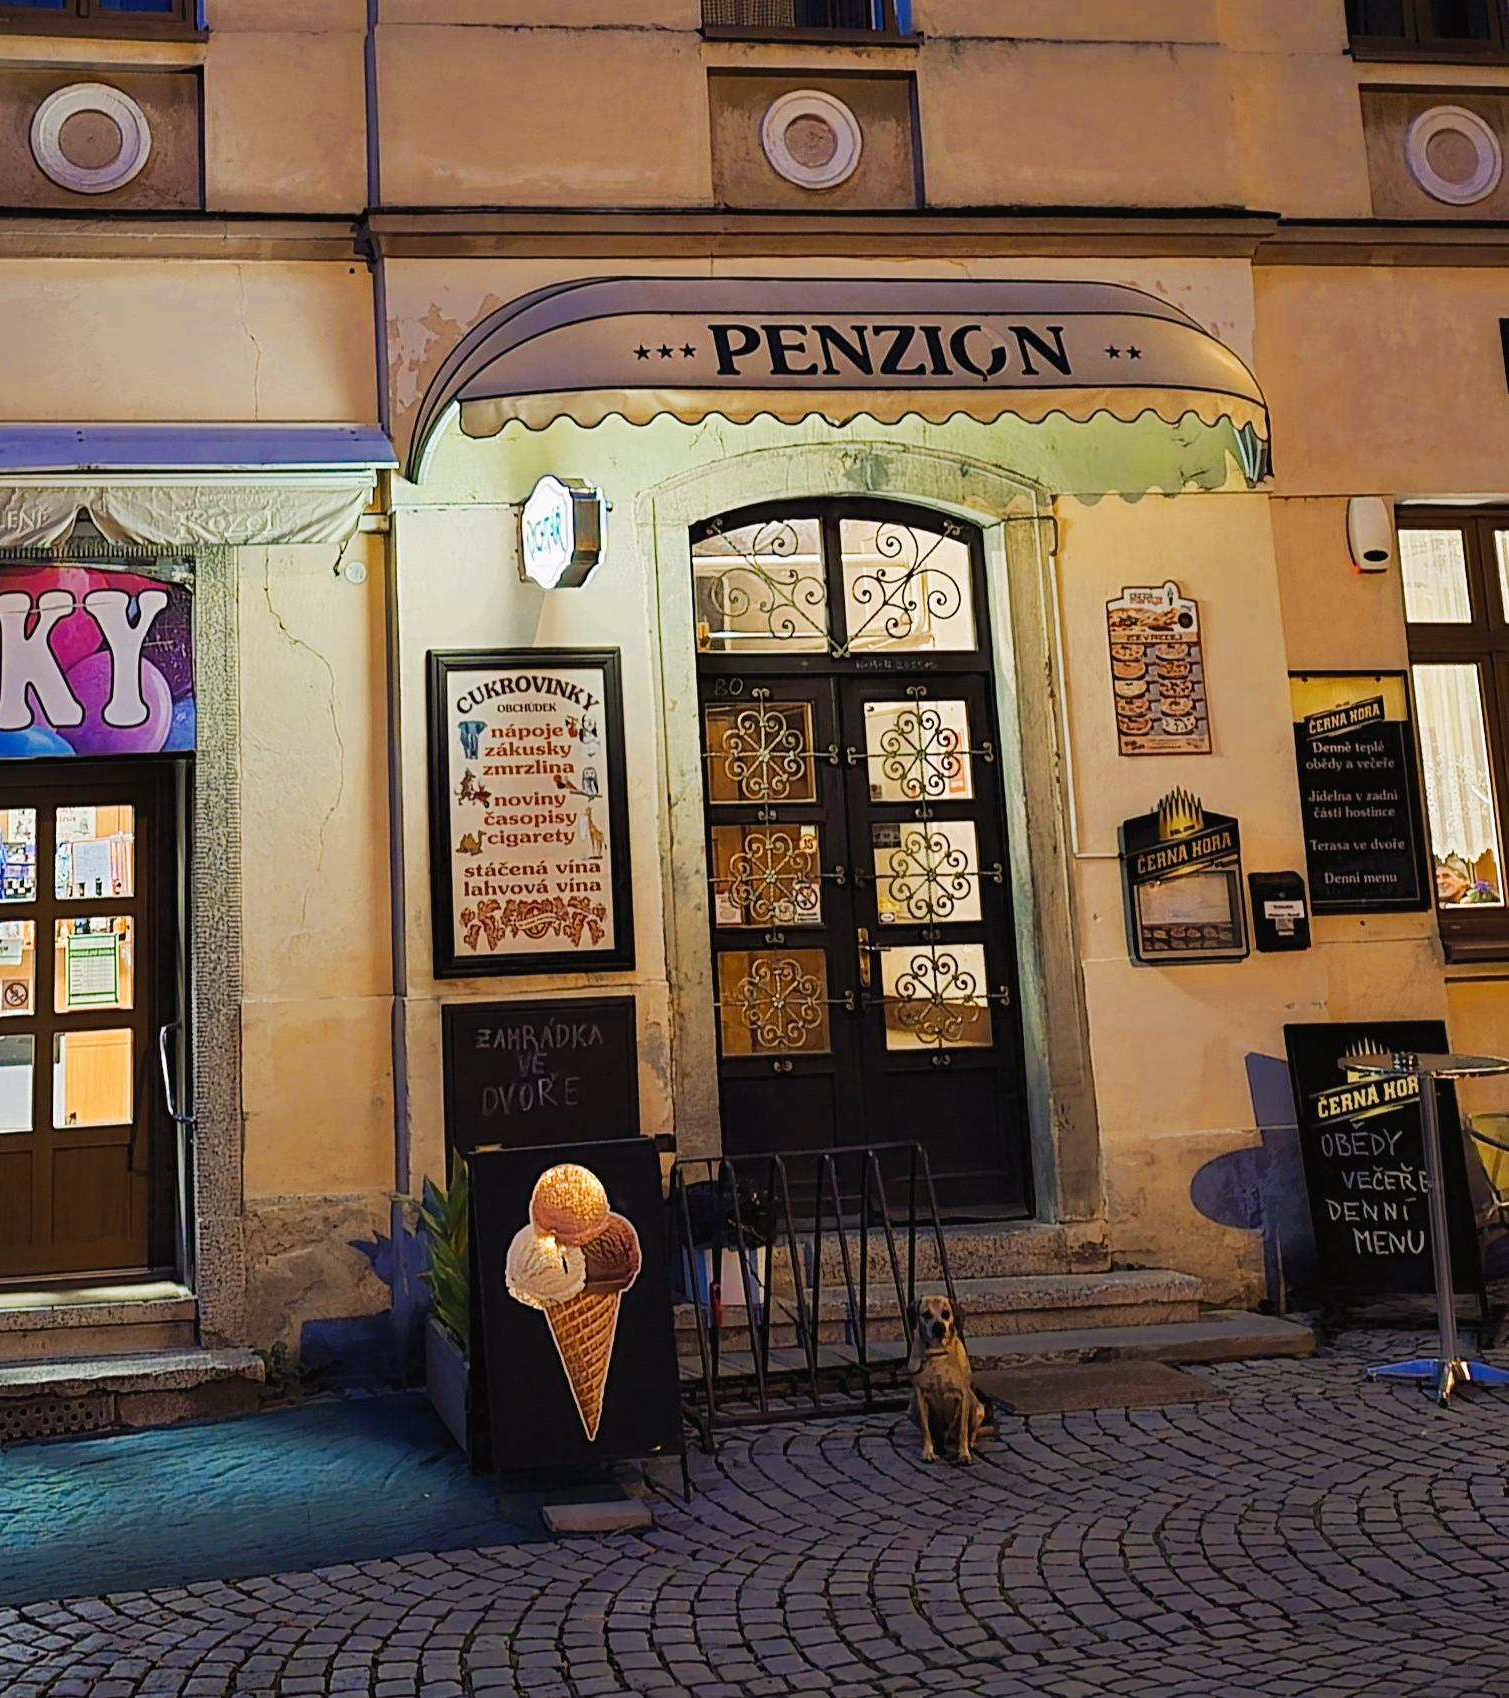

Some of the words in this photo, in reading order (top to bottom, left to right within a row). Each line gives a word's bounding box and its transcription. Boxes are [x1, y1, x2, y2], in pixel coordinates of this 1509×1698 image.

[708, 322, 1073, 382] PENZION
[456, 674, 600, 715] CUKROVINKY
[1349, 702, 1381, 723] HORA
[490, 722, 565, 742] nápoje
[484, 742, 572, 759] zákusky
[1312, 740, 1352, 754] Denně
[1354, 739, 1385, 756] teplé
[483, 760, 575, 776] zmrzlina
[1305, 757, 1343, 772] obědy
[1345, 760, 1354, 769] a
[1356, 757, 1395, 770] večeře
[494, 792, 567, 811] noviny
[1307, 788, 1352, 803] Jídelna
[1355, 793, 1363, 801] v
[1366, 787, 1399, 801] zadní
[483, 810, 578, 827] časopisy
[1313, 806, 1342, 819] části
[1345, 805, 1396, 818] hostince
[487, 828, 576, 847] cigarety
[1191, 831, 1233, 859] HORA
[1309, 839, 1351, 852] Terasa
[1353, 841, 1368, 851] ve
[1370, 836, 1405, 851] dvoře
[463, 860, 549, 878] stáčená
[556, 860, 602, 876] vína
[1323, 870, 1361, 885] Denní
[1363, 872, 1399, 884] menu
[463, 879, 550, 898] lahvová
[556, 878, 603, 894] vína
[475, 1017, 604, 1052] ZAHRÁDKA
[517, 1052, 548, 1078] VE
[482, 1072, 581, 1117] DVOŘE
[1384, 1075, 1420, 1102] HOR
[1320, 1121, 1404, 1158] OBĚDY
[1341, 1162, 1432, 1194] VEČEŘE
[1325, 1197, 1417, 1222] DENNÍ
[1352, 1227, 1426, 1256] MENU
